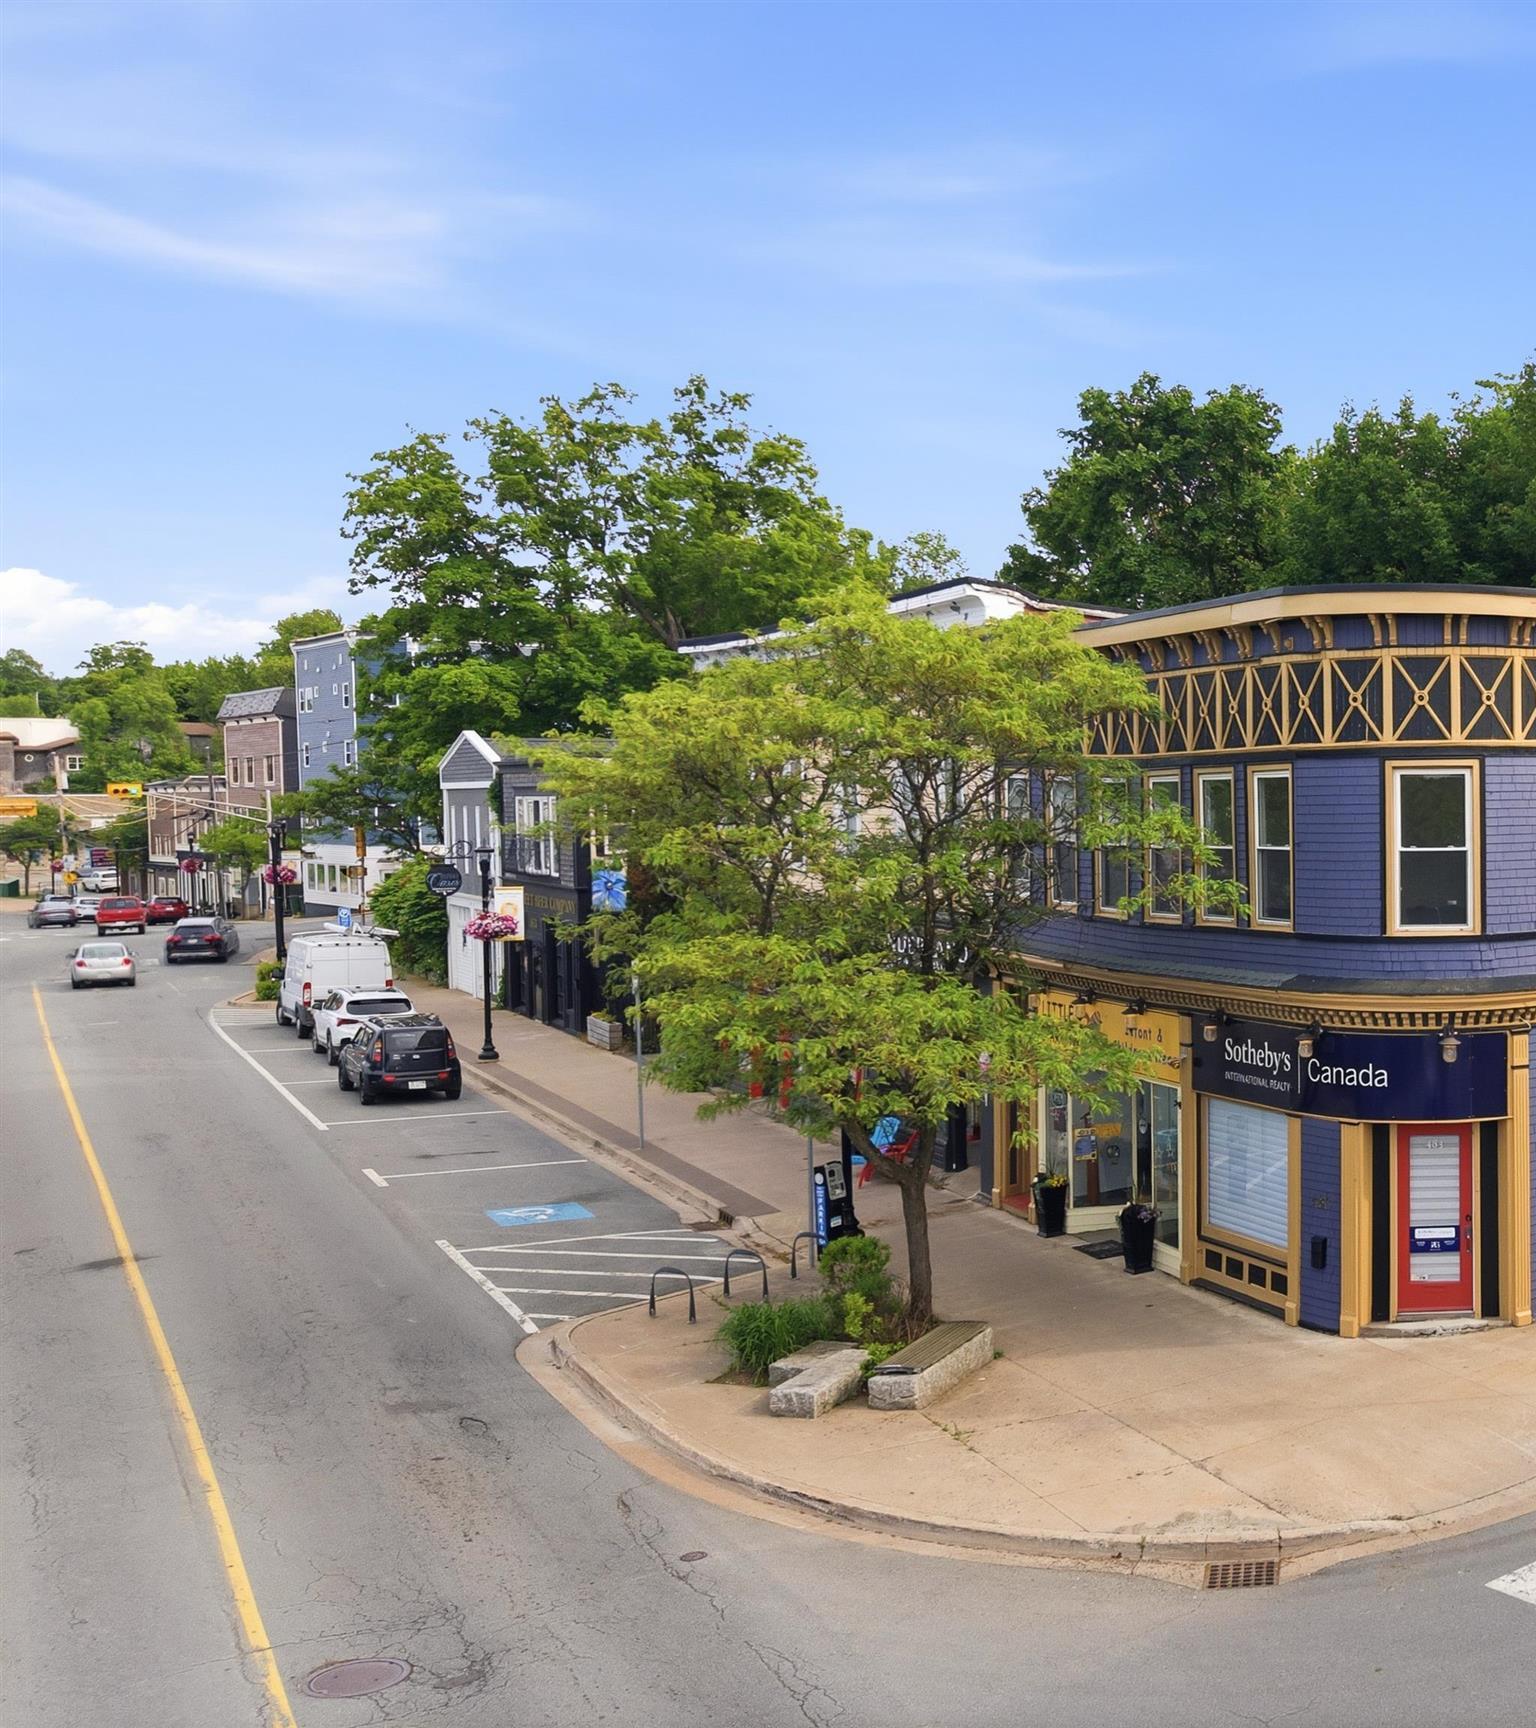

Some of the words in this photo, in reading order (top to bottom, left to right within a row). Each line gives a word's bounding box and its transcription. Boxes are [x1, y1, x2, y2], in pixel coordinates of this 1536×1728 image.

[1224, 1038, 1291, 1075] Sotheby's
[1224, 1072, 1269, 1088] INTERNATIONAL
[1269, 1079, 1291, 1092] REALTY
[1308, 1058, 1388, 1088] Canada
